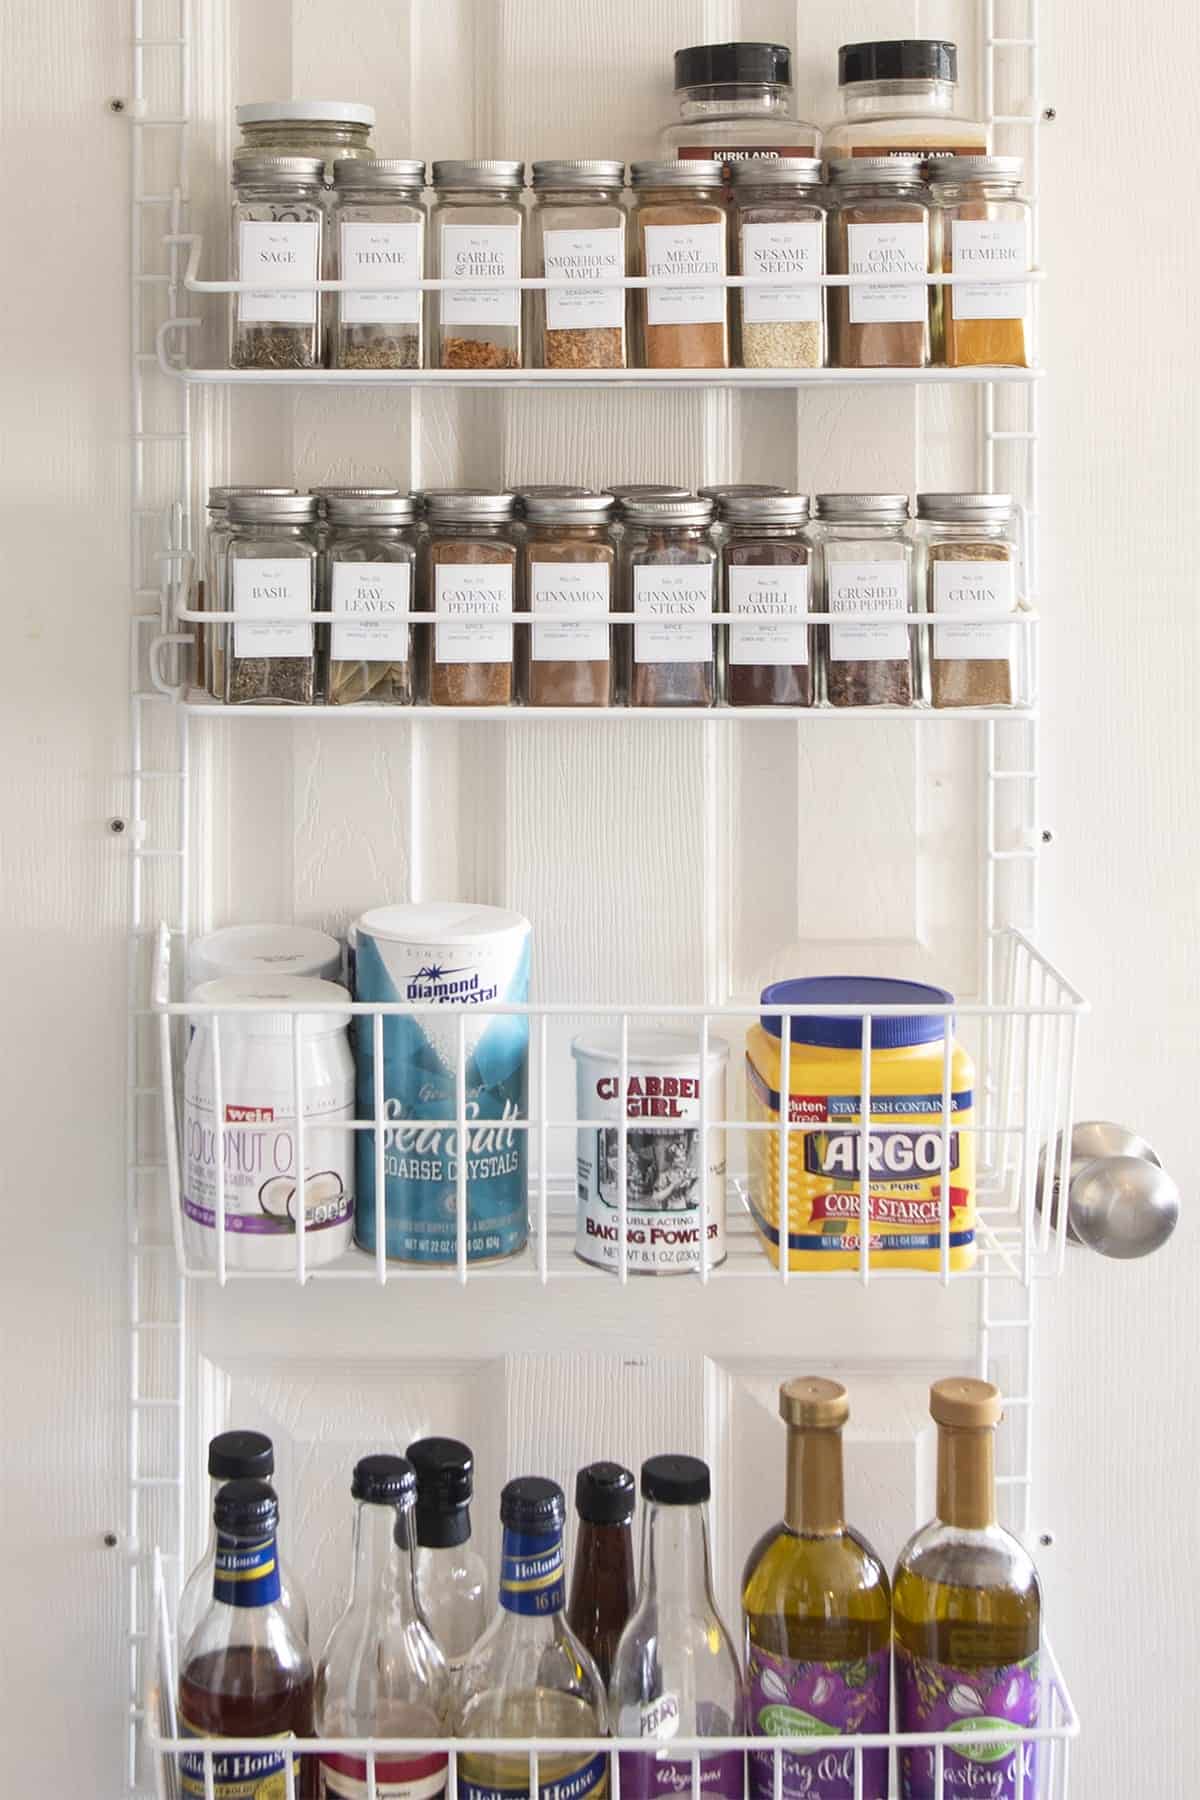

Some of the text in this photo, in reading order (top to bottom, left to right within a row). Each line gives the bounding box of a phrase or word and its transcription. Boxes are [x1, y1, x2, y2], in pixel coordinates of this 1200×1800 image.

[713, 150, 779, 160] KIRKLAND
[259, 251, 296, 264] SAGE
[355, 251, 406, 265] THYME
[456, 251, 505, 264] GARLIC
[666, 249, 703, 263] MEAT
[753, 248, 808, 261] SESAME
[868, 249, 906, 263] CAJUN
[960, 247, 1017, 261] TUMERIC
[548, 255, 617, 268] SMOKEHOUSE
[760, 261, 804, 273] SEEDS
[455, 264, 505, 276] & HERB
[564, 267, 603, 279] MAPLE
[650, 262, 719, 276] TENDERIZER
[252, 586, 288, 599] BASIL
[357, 587, 383, 600] BAY
[442, 590, 505, 601] CAYENNE
[535, 590, 605, 601] CINNAMON
[638, 590, 707, 602] CINNAMON
[748, 591, 788, 603] CHILI
[838, 586, 897, 599] CRUSHED
[948, 589, 996, 601] CUMIN
[344, 599, 395, 613] LEAVES
[448, 601, 499, 614] PEPPER
[649, 602, 696, 614] STICKS
[738, 603, 798, 615] POWDER
[833, 599, 857, 612] RED
[407, 973, 479, 999] Diamond
[627, 1098, 682, 1118] GIRL
[894, 1099, 959, 1113] CONTAINR
[227, 1109, 273, 1121] weis
[823, 1134, 943, 1172] ARGO
[825, 1194, 874, 1213] CORN
[879, 1198, 943, 1219] STARCH
[612, 1215, 694, 1226] DUBLE ACTING
[515, 1550, 562, 1579] Holland
[1006, 1743, 1032, 1781] Ol
